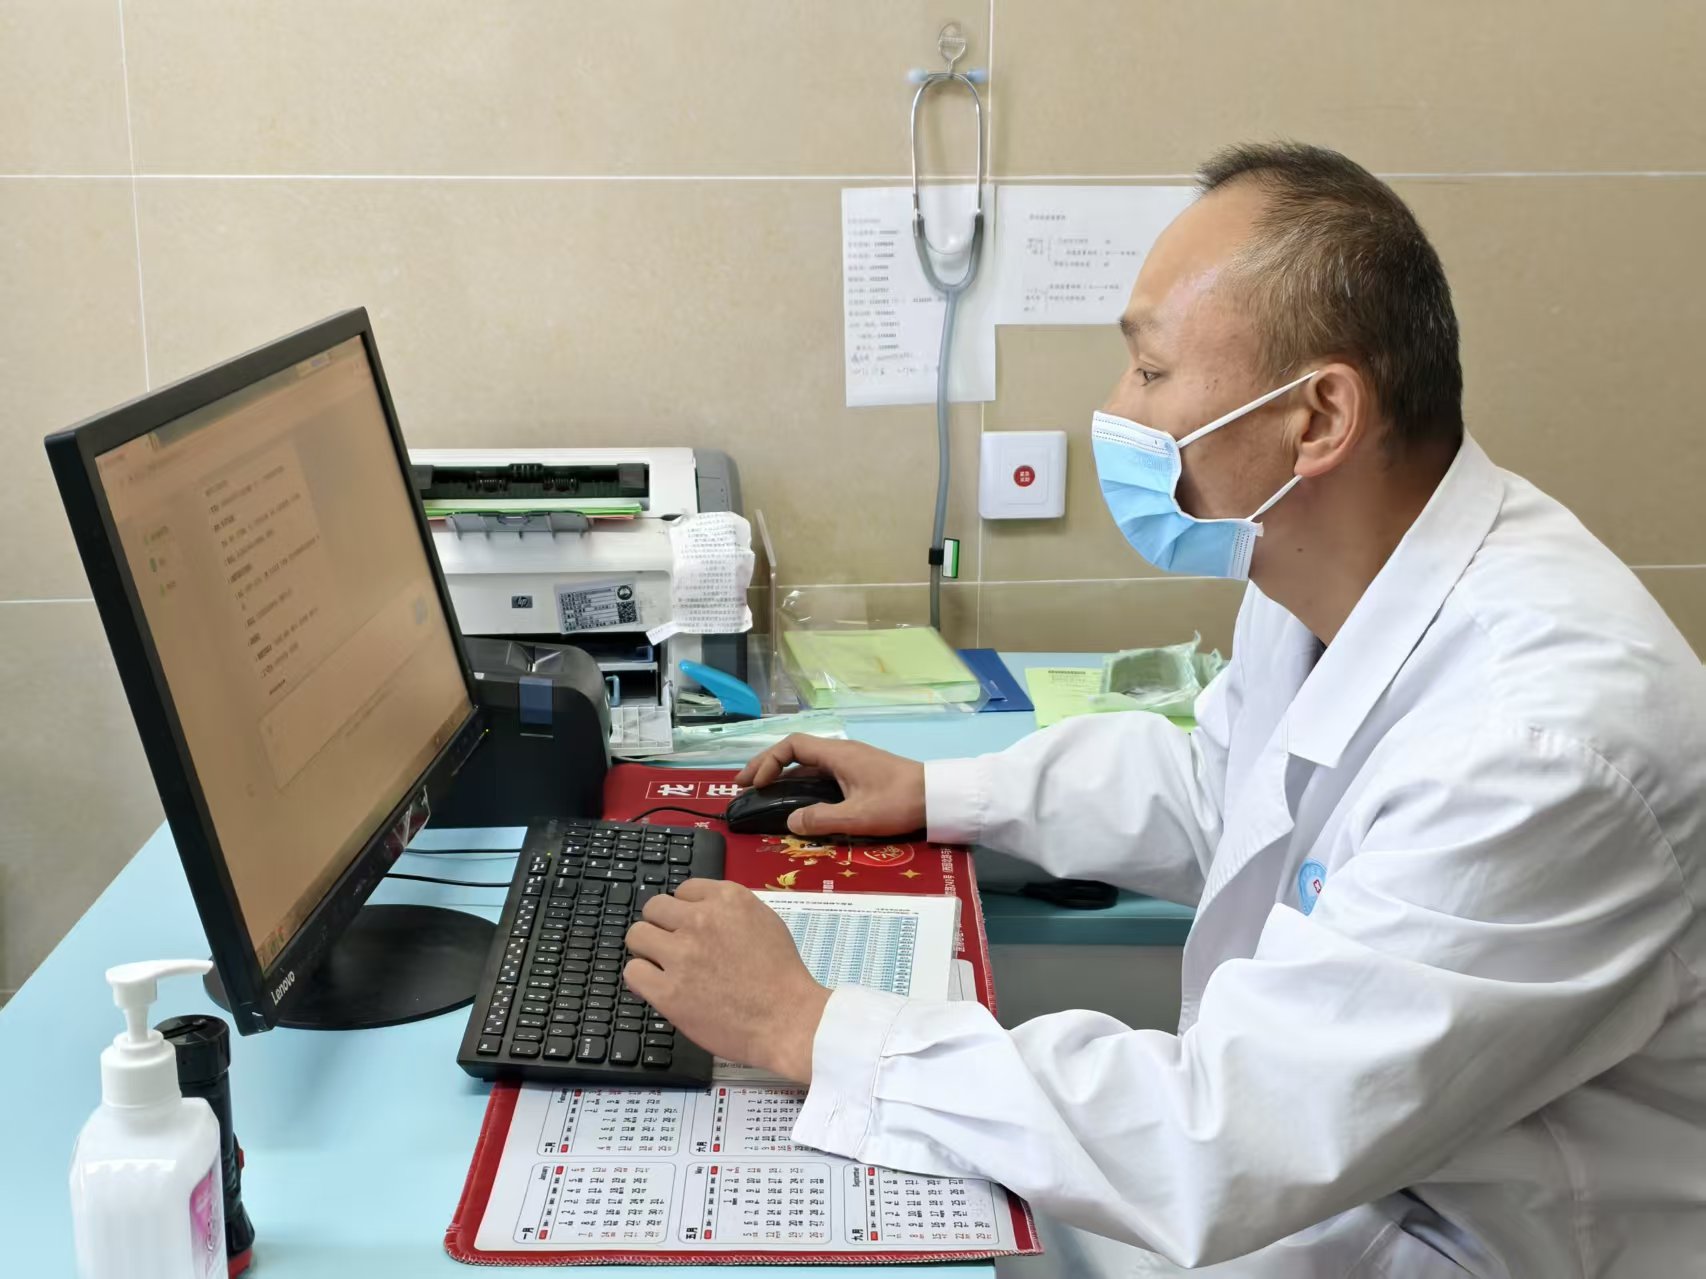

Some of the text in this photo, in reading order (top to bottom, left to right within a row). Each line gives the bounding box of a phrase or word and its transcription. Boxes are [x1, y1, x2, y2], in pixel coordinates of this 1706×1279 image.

[657, 783, 743, 797] 龙年
[271, 971, 295, 1006] Lenovo
[544, 1141, 556, 1153] 二月
[695, 1141, 708, 1152] 六月
[537, 1166, 551, 1181] January
[852, 1167, 861, 1188] September
[522, 1227, 534, 1240] 一月
[685, 1227, 698, 1240] 五月
[851, 1229, 863, 1241] 九月
